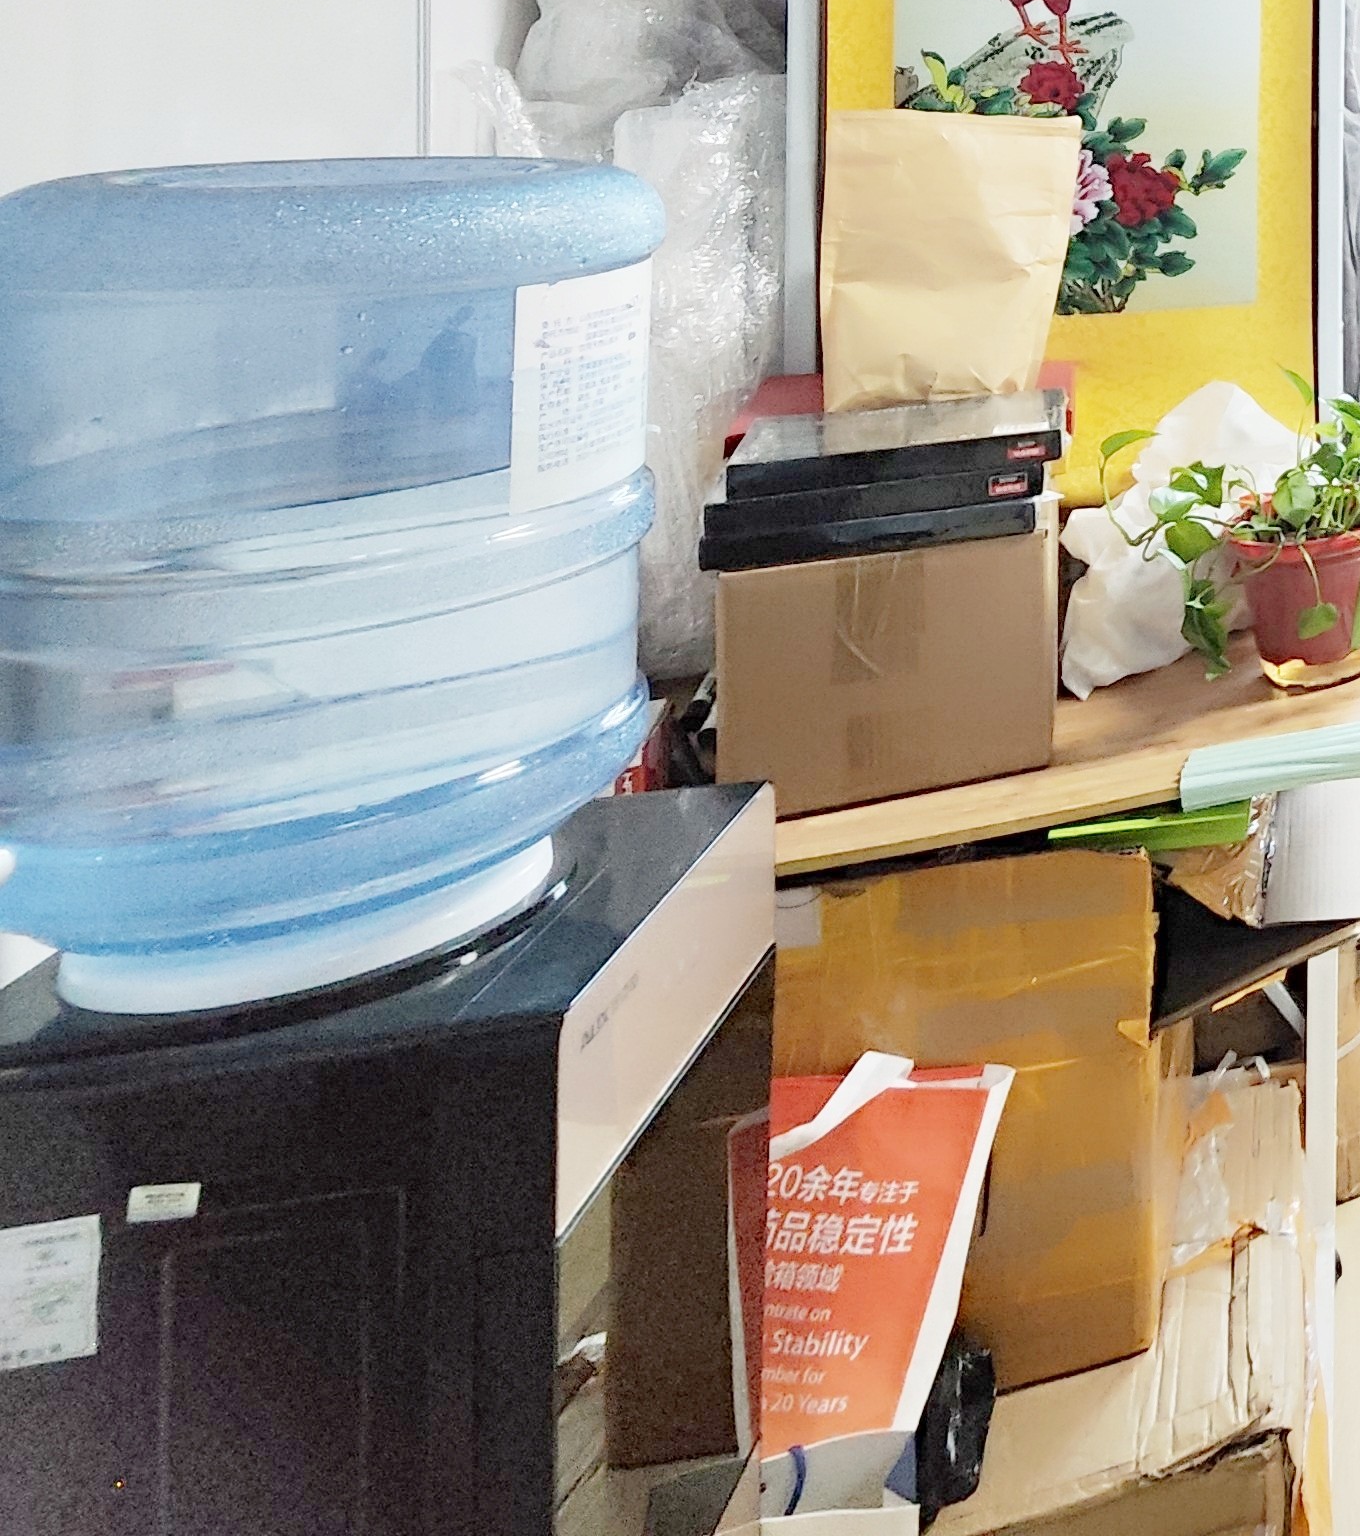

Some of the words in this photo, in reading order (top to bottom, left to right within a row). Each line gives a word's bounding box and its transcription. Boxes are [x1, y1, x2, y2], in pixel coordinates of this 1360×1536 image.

[809, 1307, 832, 1322] on
[769, 1327, 871, 1362] Stability
[801, 1365, 828, 1384] for
[769, 1392, 795, 1414] 20
[799, 1392, 849, 1415] Years
